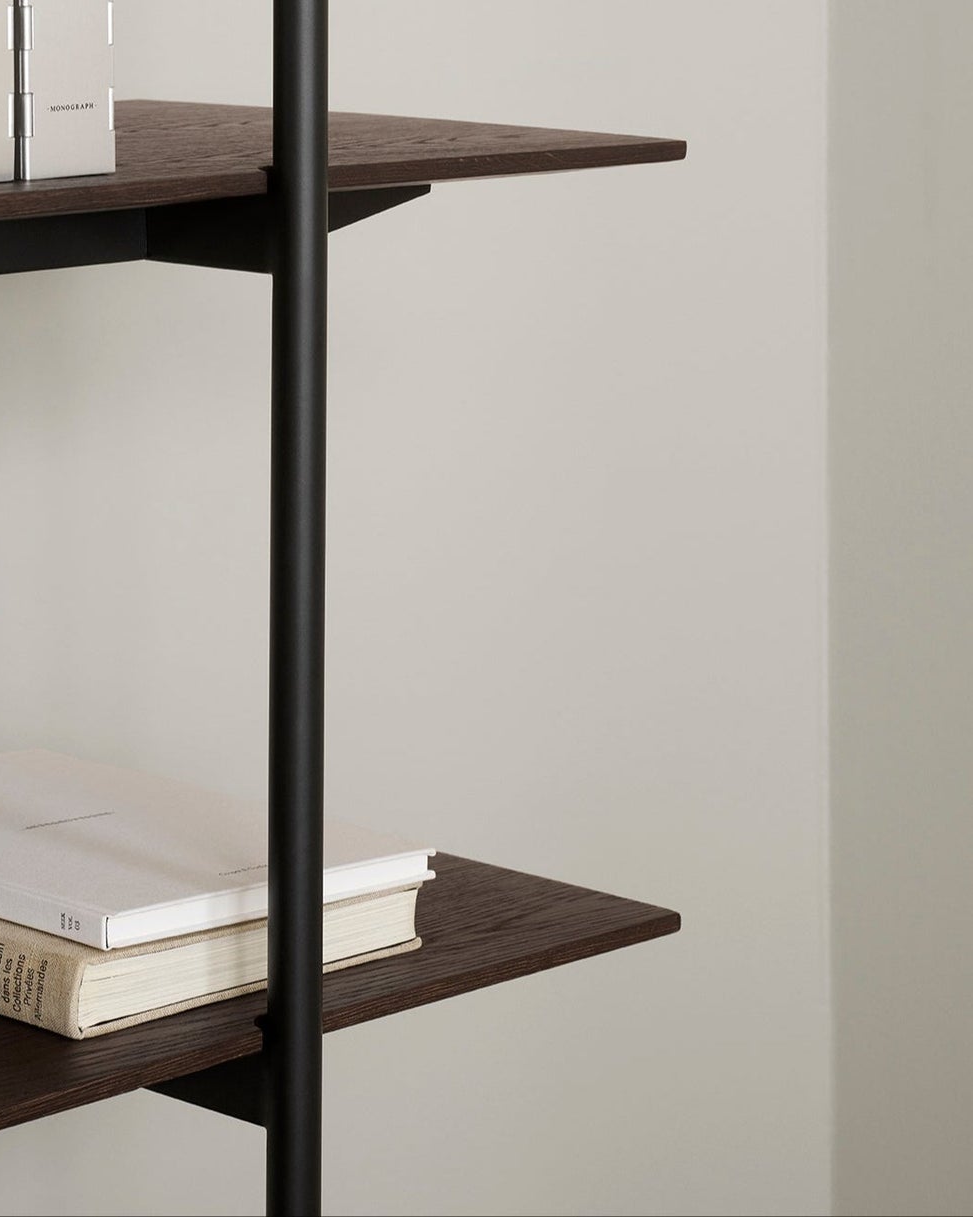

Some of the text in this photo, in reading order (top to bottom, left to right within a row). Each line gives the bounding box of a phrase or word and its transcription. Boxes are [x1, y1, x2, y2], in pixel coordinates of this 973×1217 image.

[1, 958, 13, 1004] dans les
[13, 954, 26, 1012] Collections
